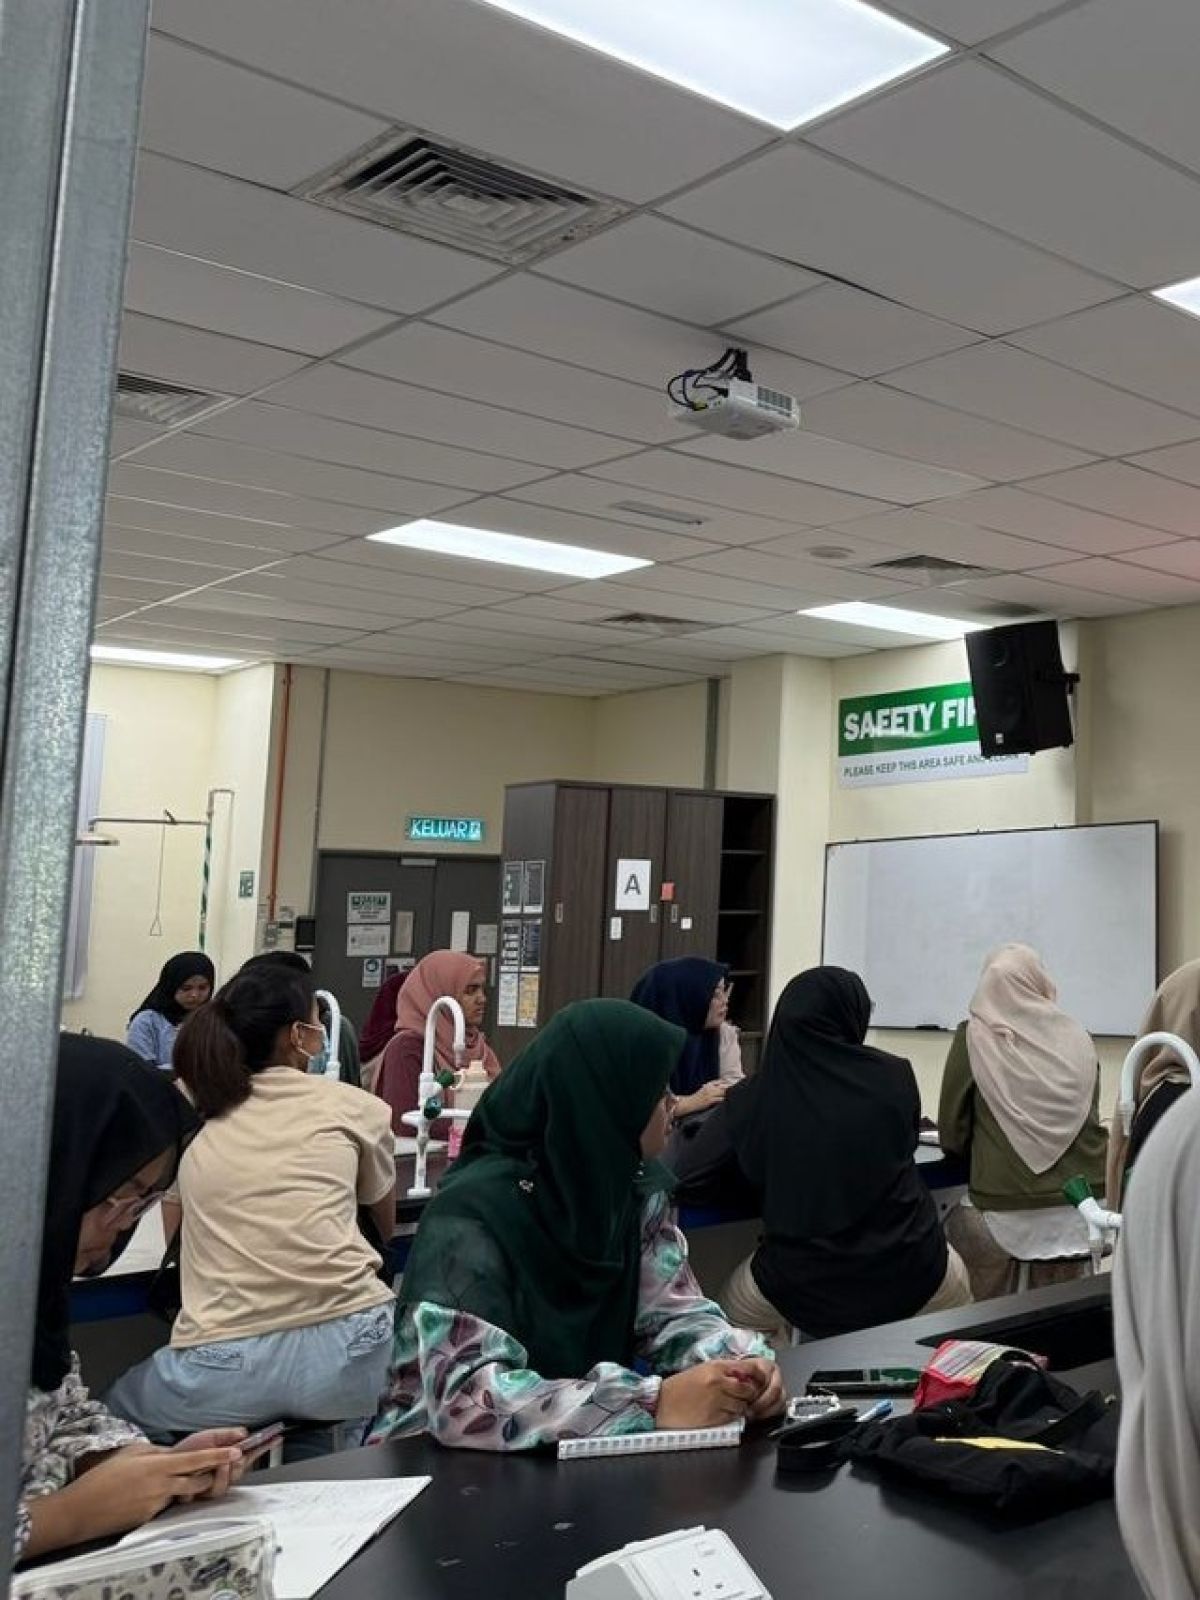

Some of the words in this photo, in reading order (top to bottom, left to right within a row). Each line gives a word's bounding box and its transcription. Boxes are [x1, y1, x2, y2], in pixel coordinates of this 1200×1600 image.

[844, 765, 875, 778] PLEASE
[876, 761, 897, 774] KEEP
[899, 759, 917, 771] THIS
[919, 757, 941, 769] AREA
[943, 755, 966, 766] SAFE
[411, 819, 469, 839] KELUAR
[624, 873, 642, 896] A
